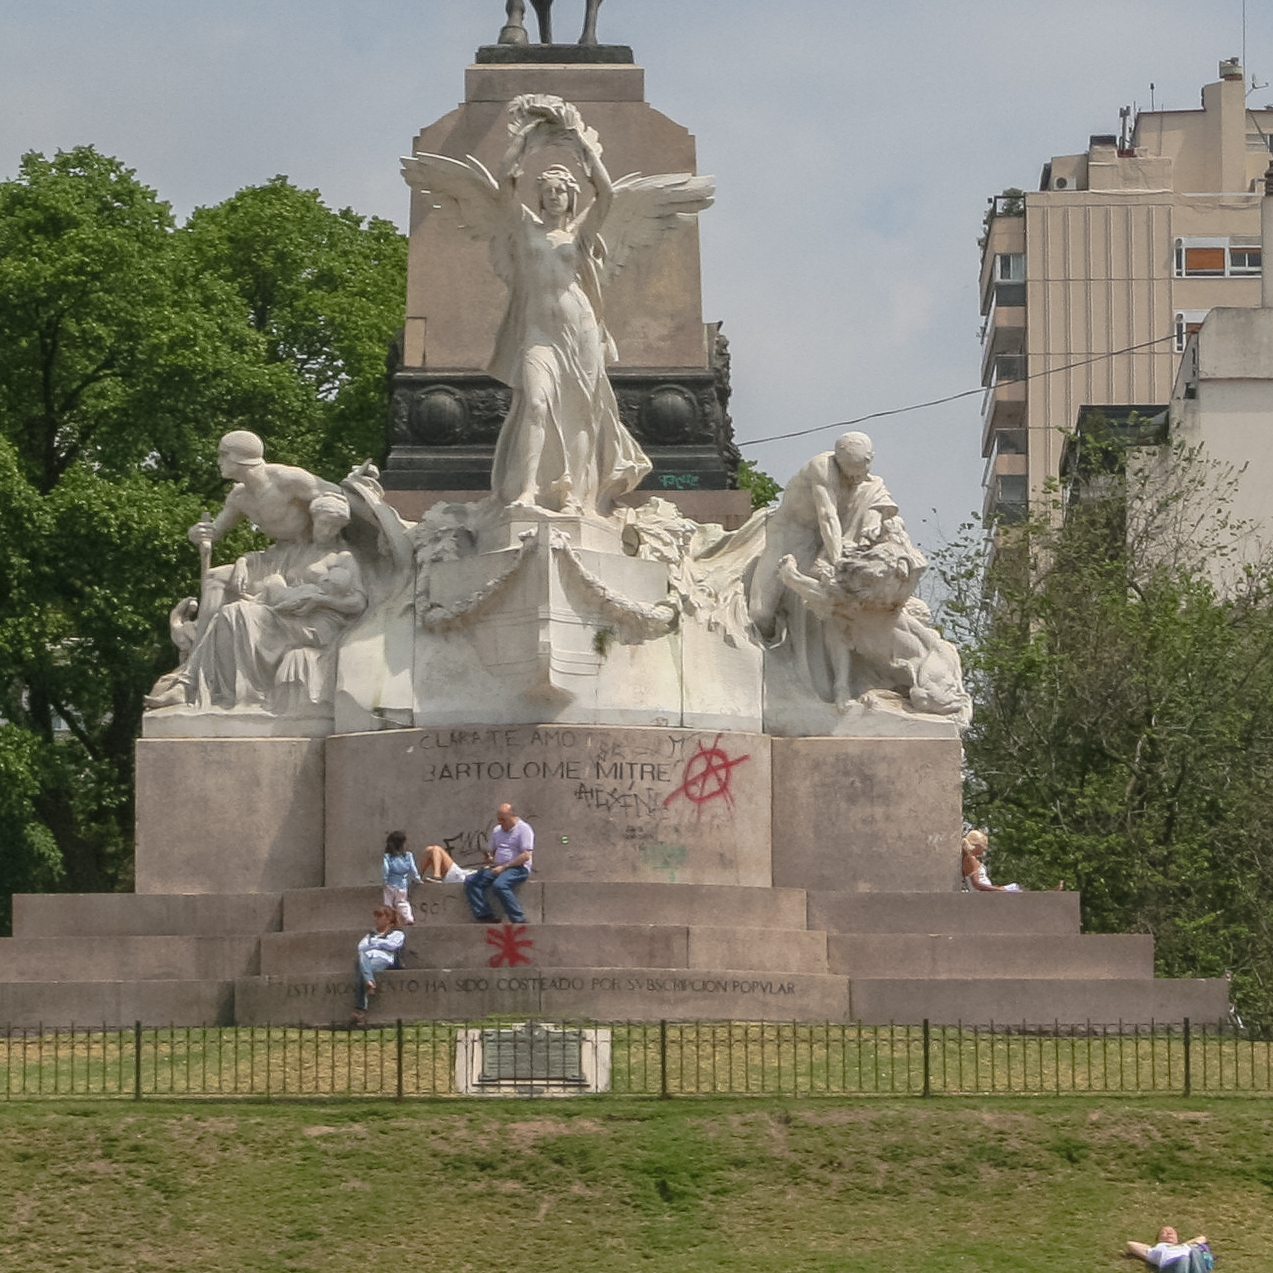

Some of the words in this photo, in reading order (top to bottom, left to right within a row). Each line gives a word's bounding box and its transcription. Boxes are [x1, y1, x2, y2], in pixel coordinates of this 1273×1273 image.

[488, 729, 520, 746] TE
[530, 730, 576, 748] AMO
[423, 761, 580, 781] BARTOLOME
[596, 761, 670, 782] MITRE
[426, 980, 447, 993] HA
[455, 978, 489, 992] SIDO
[496, 978, 584, 992] COSTEADO
